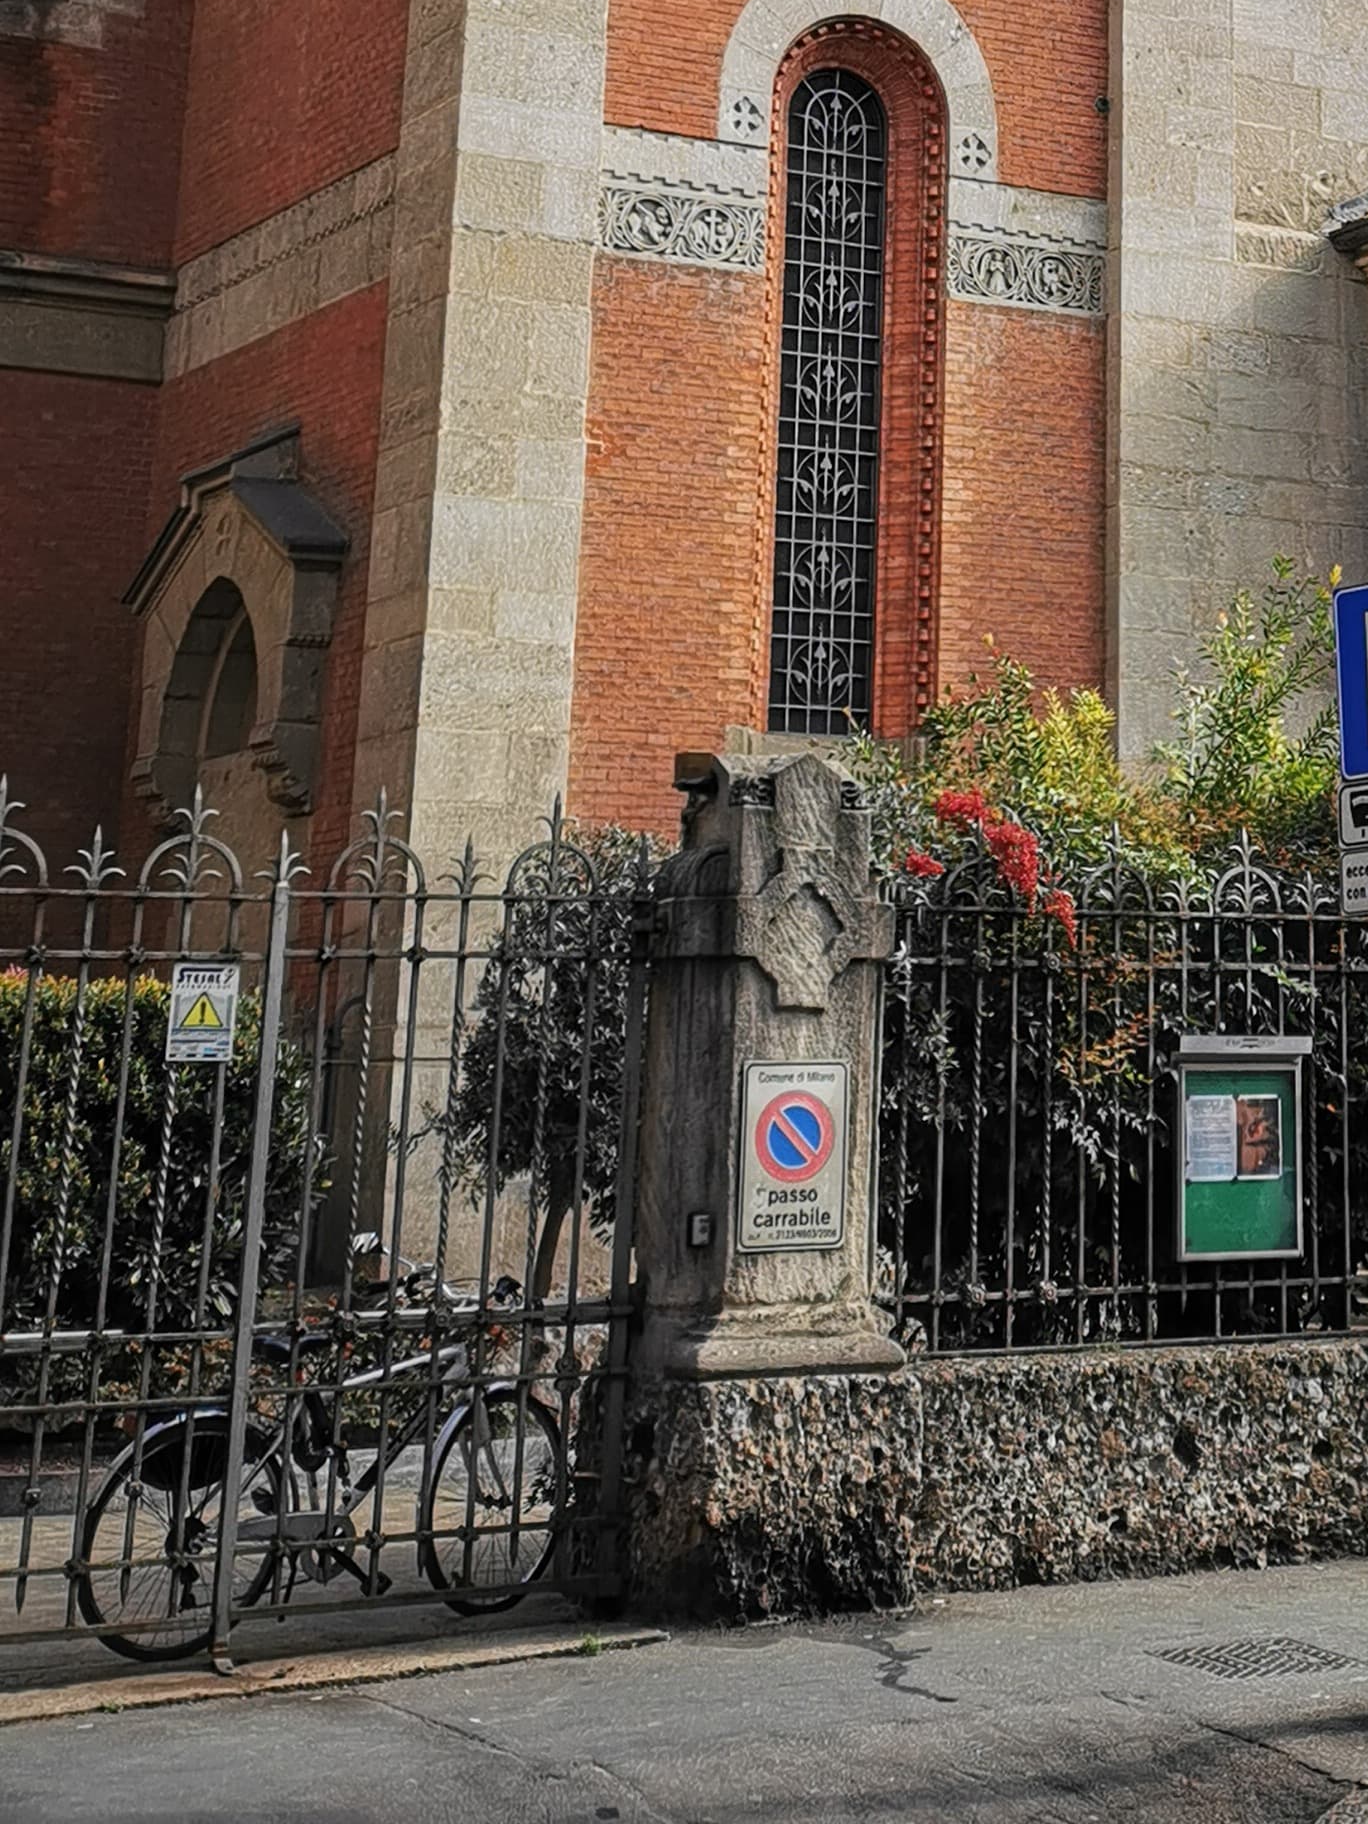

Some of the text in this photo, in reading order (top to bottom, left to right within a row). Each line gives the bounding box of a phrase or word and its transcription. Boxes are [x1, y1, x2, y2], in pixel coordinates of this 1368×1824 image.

[1346, 887, 1366, 900] con
[758, 1071, 794, 1084] Comune
[806, 1071, 835, 1083] Milano
[768, 1188, 818, 1207] passo
[753, 1206, 831, 1228] carrabile
